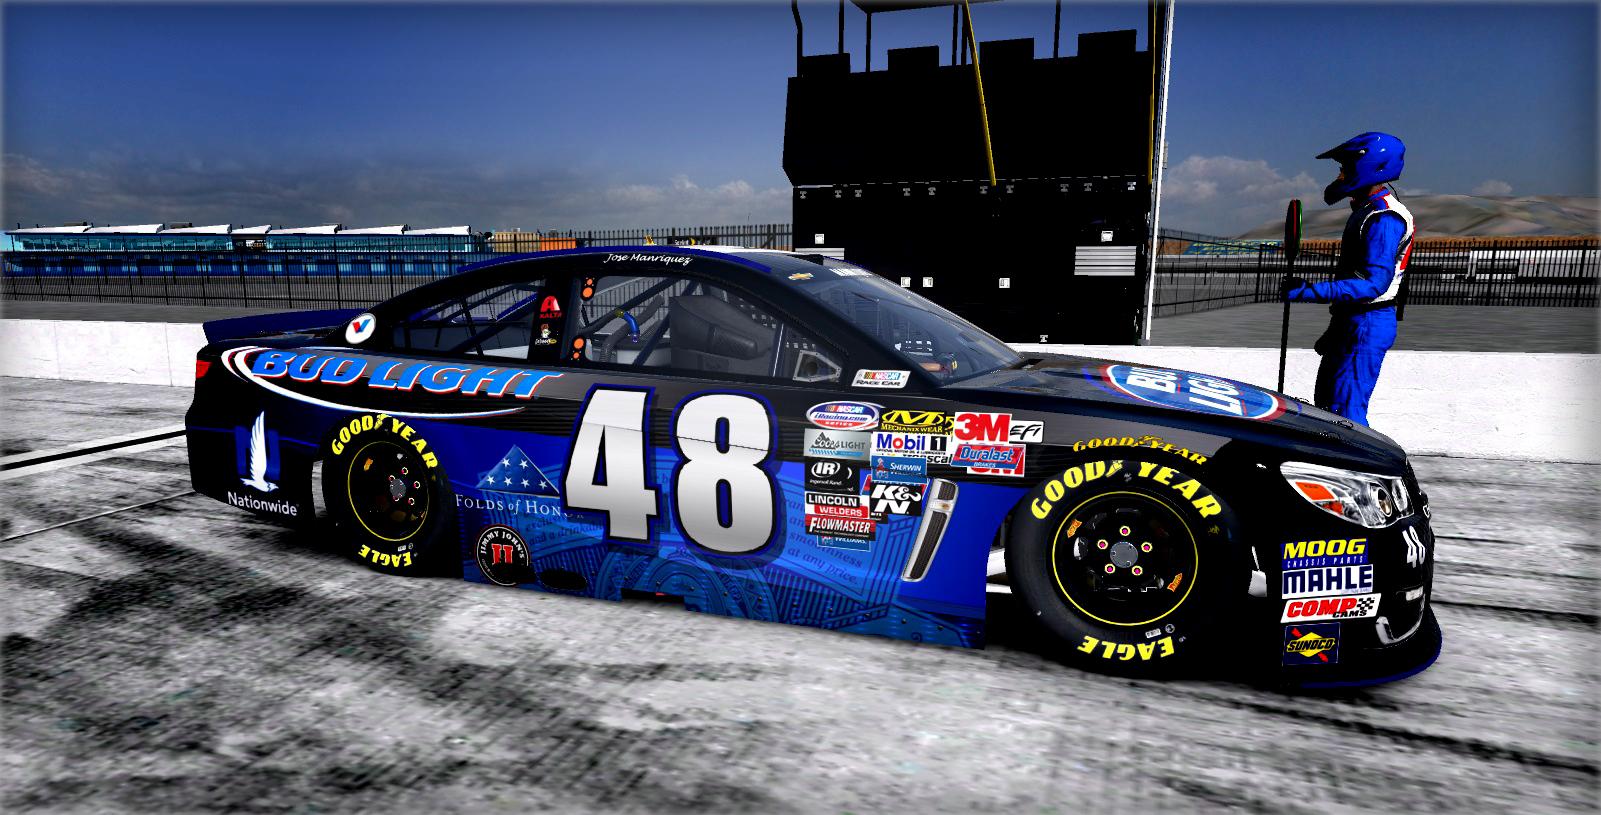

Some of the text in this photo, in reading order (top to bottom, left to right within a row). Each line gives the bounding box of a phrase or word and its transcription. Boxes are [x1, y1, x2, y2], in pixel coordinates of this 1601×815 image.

[603, 253, 693, 266] Jose Manriquez
[251, 350, 564, 399] BUD LIGHT
[954, 412, 1011, 443] 3M
[1009, 424, 1043, 441] EFI
[840, 440, 866, 450] LIGHT
[876, 433, 947, 451] Mobil 1
[960, 446, 1015, 463] Duralast
[565, 388, 775, 553] 48
[889, 462, 922, 472] SHERWIN
[227, 490, 298, 517] Nationwide
[455, 494, 504, 511] FOLDS
[508, 500, 521, 514] of
[808, 494, 858, 507] LINCOLN
[819, 505, 863, 517] WELDERS
[808, 516, 871, 534] FLOWMASTER
[480, 530, 525, 559] JIMMY JOHN'S
[1283, 538, 1367, 560] MOOG
[1402, 526, 1426, 568] 48
[357, 544, 413, 568] EAGLE
[1287, 555, 1363, 569] CHASSIS PARTS
[1283, 565, 1372, 595] MAHLE
[1286, 597, 1358, 618] COMP
[1332, 609, 1367, 618] CAMS
[1077, 635, 1175, 661] EAGLE
[1288, 639, 1334, 651] SUNOCO
